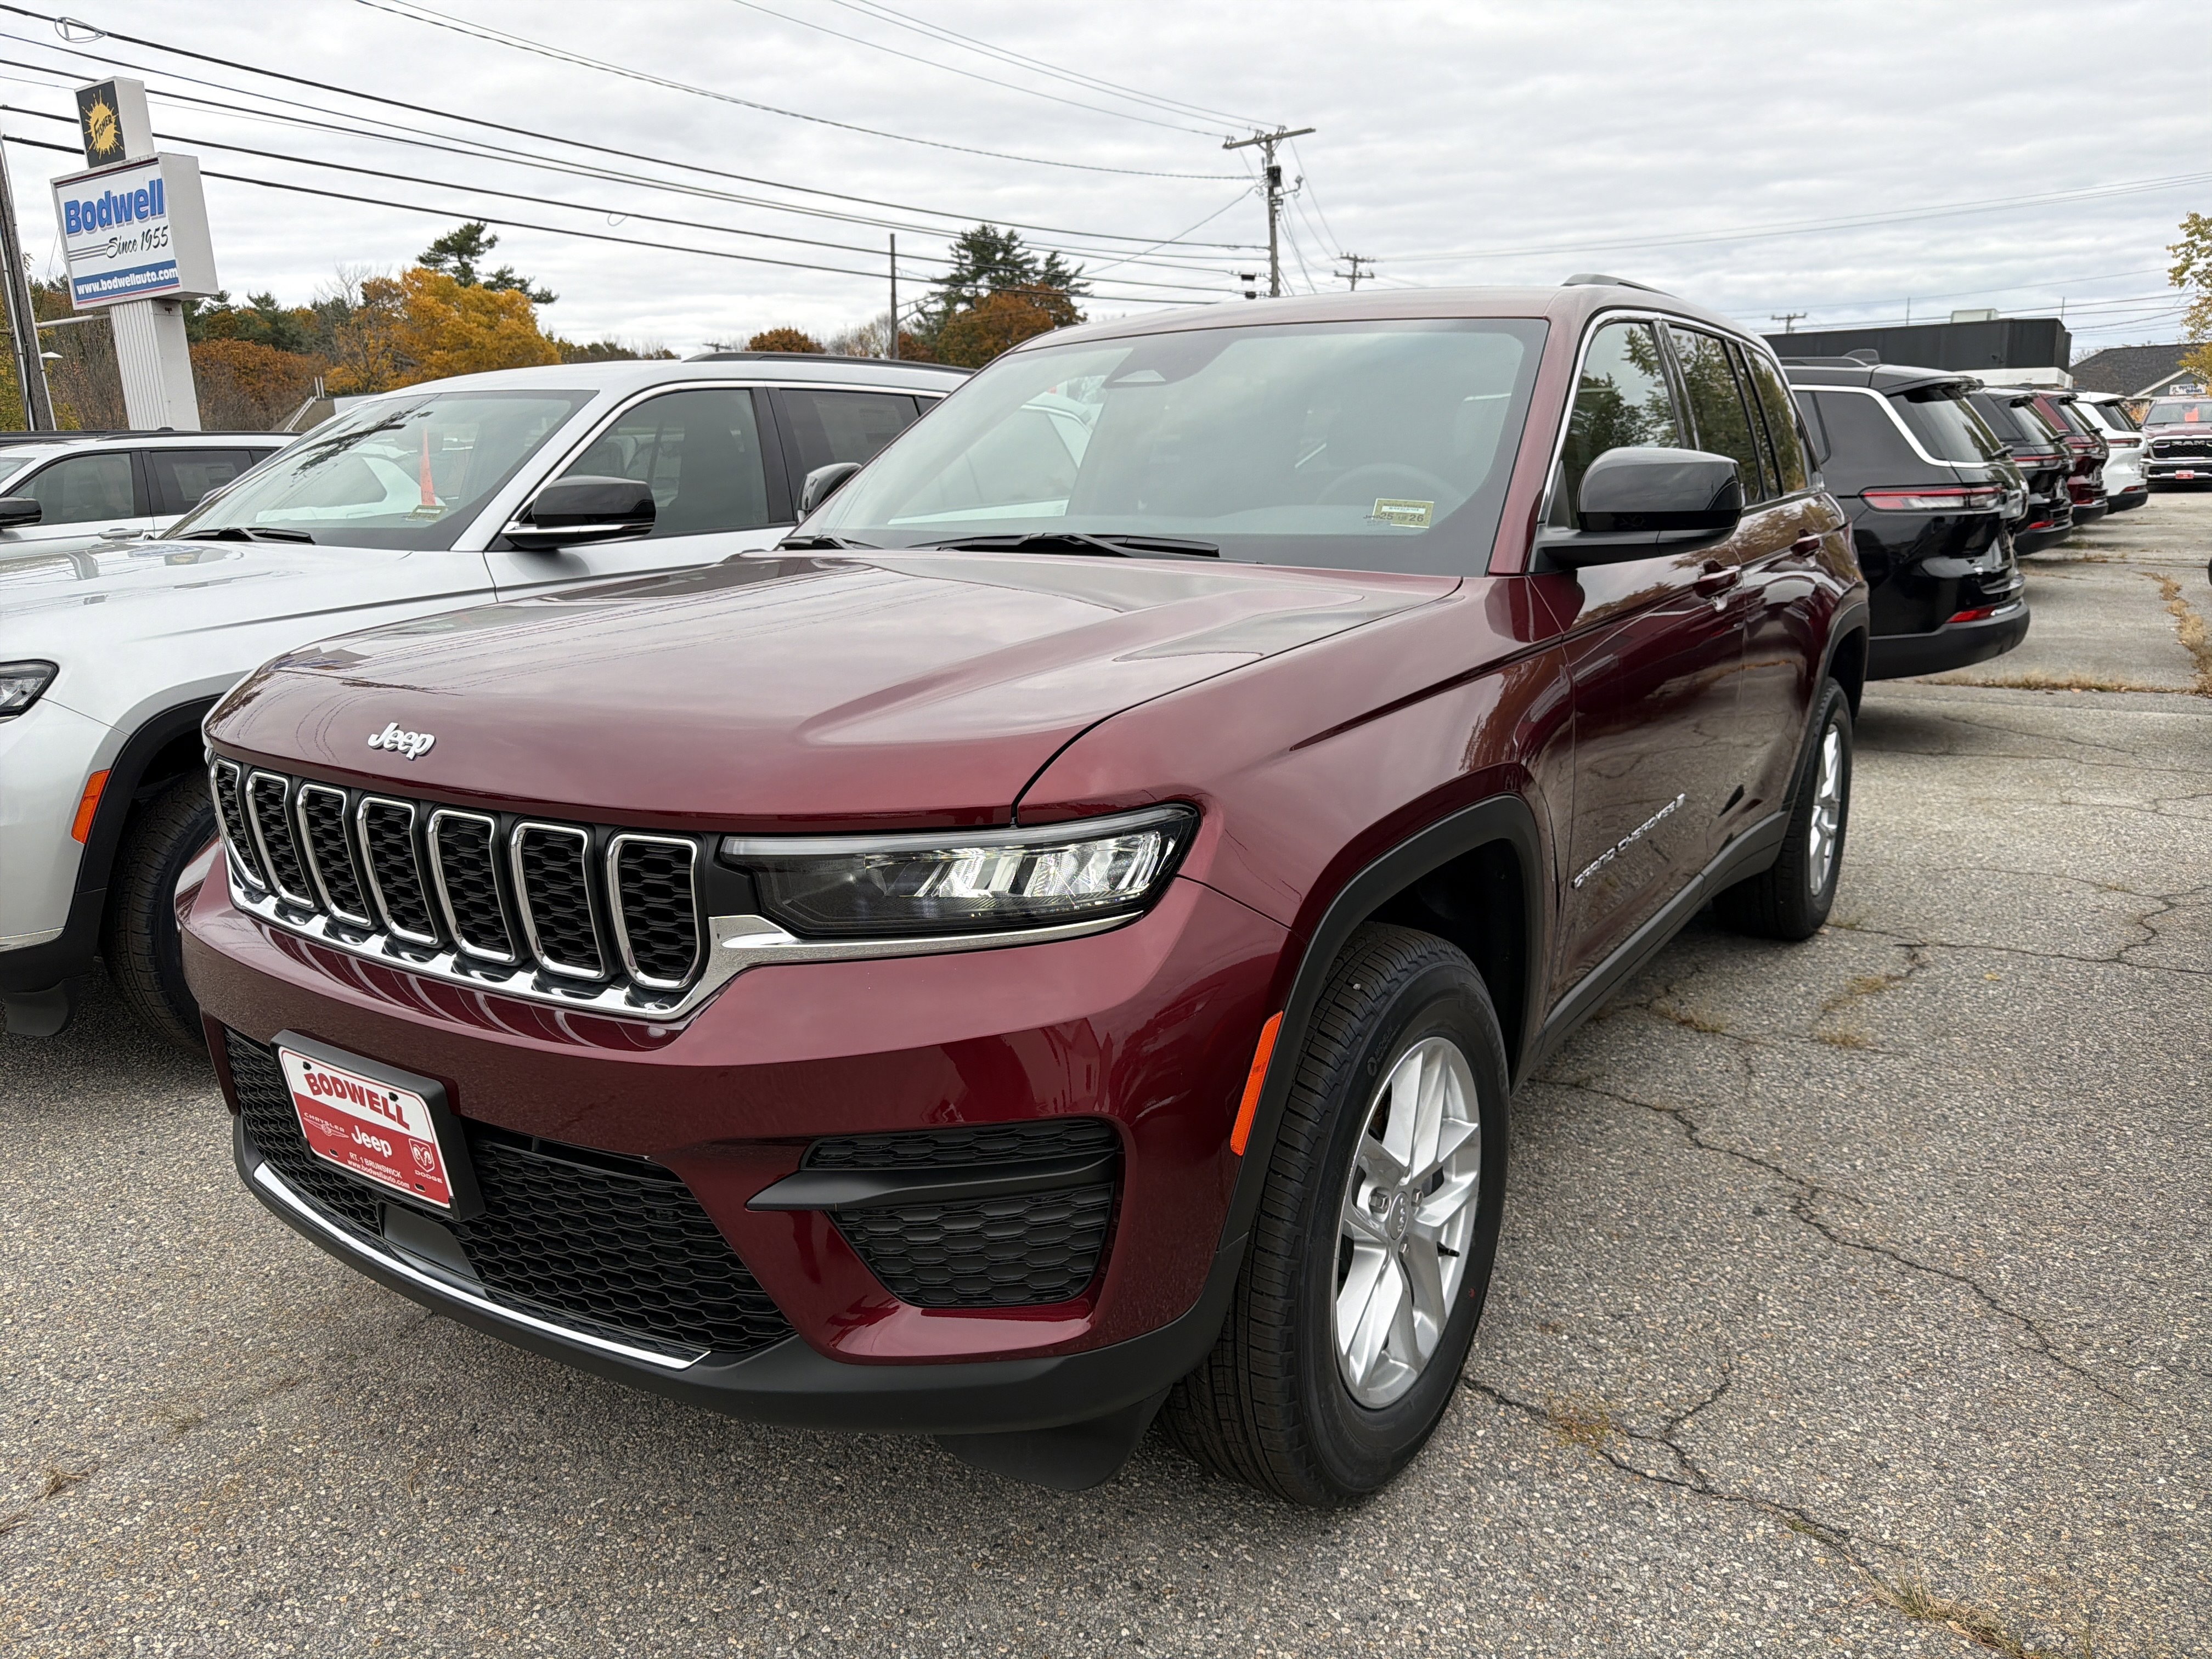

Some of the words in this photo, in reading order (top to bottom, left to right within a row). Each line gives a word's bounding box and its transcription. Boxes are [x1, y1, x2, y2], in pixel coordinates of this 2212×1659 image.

[93, 114, 113, 144] FISHER
[64, 178, 165, 236] Bodwell
[106, 235, 137, 258] Since
[140, 225, 168, 251] 1955
[76, 267, 178, 295] www.bodwellauto.com
[368, 722, 435, 761] Jeep
[303, 1073, 410, 1131] BODWELL
[304, 1112, 345, 1133] CHRYSLER
[351, 1125, 392, 1158] Jeep
[347, 1159, 410, 1189] www.bodwellauto.com
[349, 1152, 360, 1162] RT.
[364, 1158, 403, 1179] BRUNSWICK
[415, 1170, 443, 1183] DODGE
